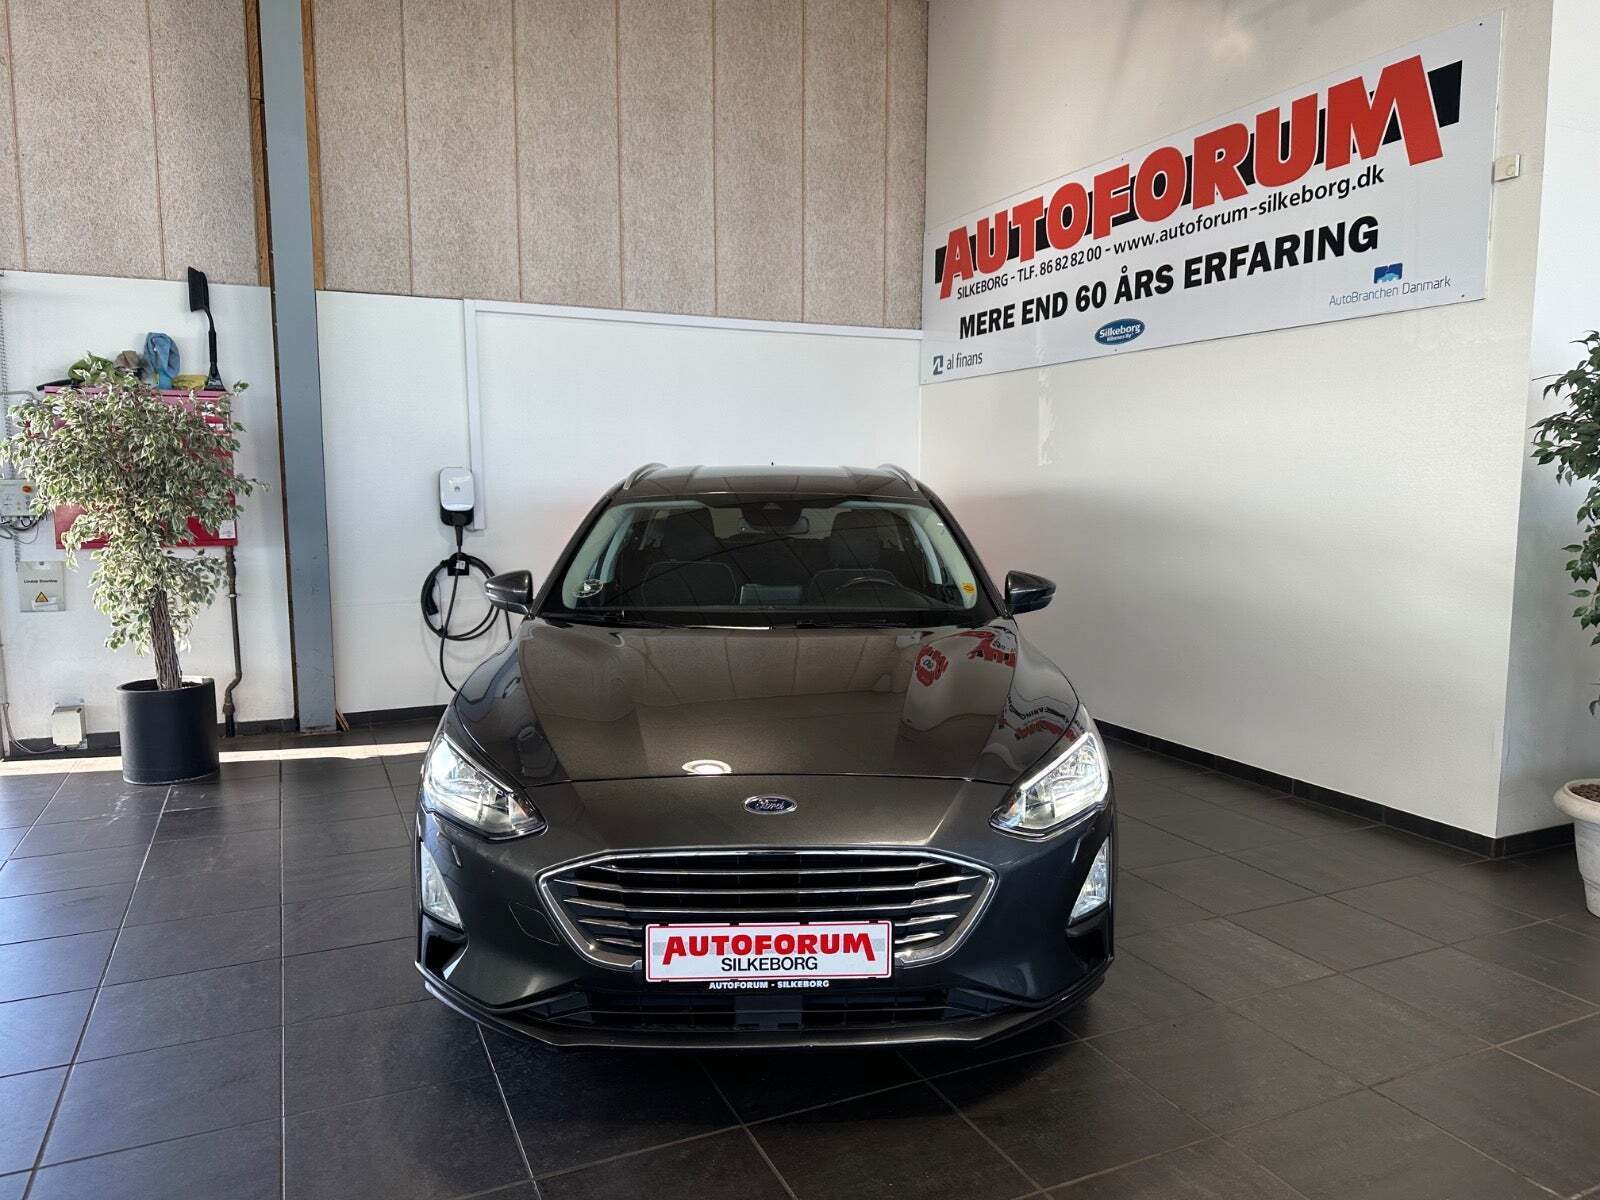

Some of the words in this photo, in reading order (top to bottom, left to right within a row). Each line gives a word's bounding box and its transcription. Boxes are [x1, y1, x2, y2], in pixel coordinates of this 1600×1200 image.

[939, 54, 1444, 300] AUTOFORUM
[957, 274, 1008, 300] SILKEBORG
[1017, 264, 1038, 282] TLF.
[1113, 164, 1385, 255] www.autoforum-silkeborg.dk
[960, 303, 1016, 340] MERE
[1021, 291, 1069, 325] END
[1075, 281, 1107, 313] 60
[1114, 264, 1174, 304] ÅRS
[1184, 215, 1379, 289] ERFARING
[1329, 286, 1399, 308] AutoBranchen
[1402, 275, 1451, 295] Danmark
[1099, 324, 1141, 338] Silkeborg
[946, 353, 954, 370] al
[956, 352, 983, 369] finans
[662, 932, 876, 966] AUTOFORUM
[721, 956, 818, 972] SILKEBORG
[708, 980, 769, 990] AUTOFORUM
[777, 979, 830, 989] SILKEBORG
